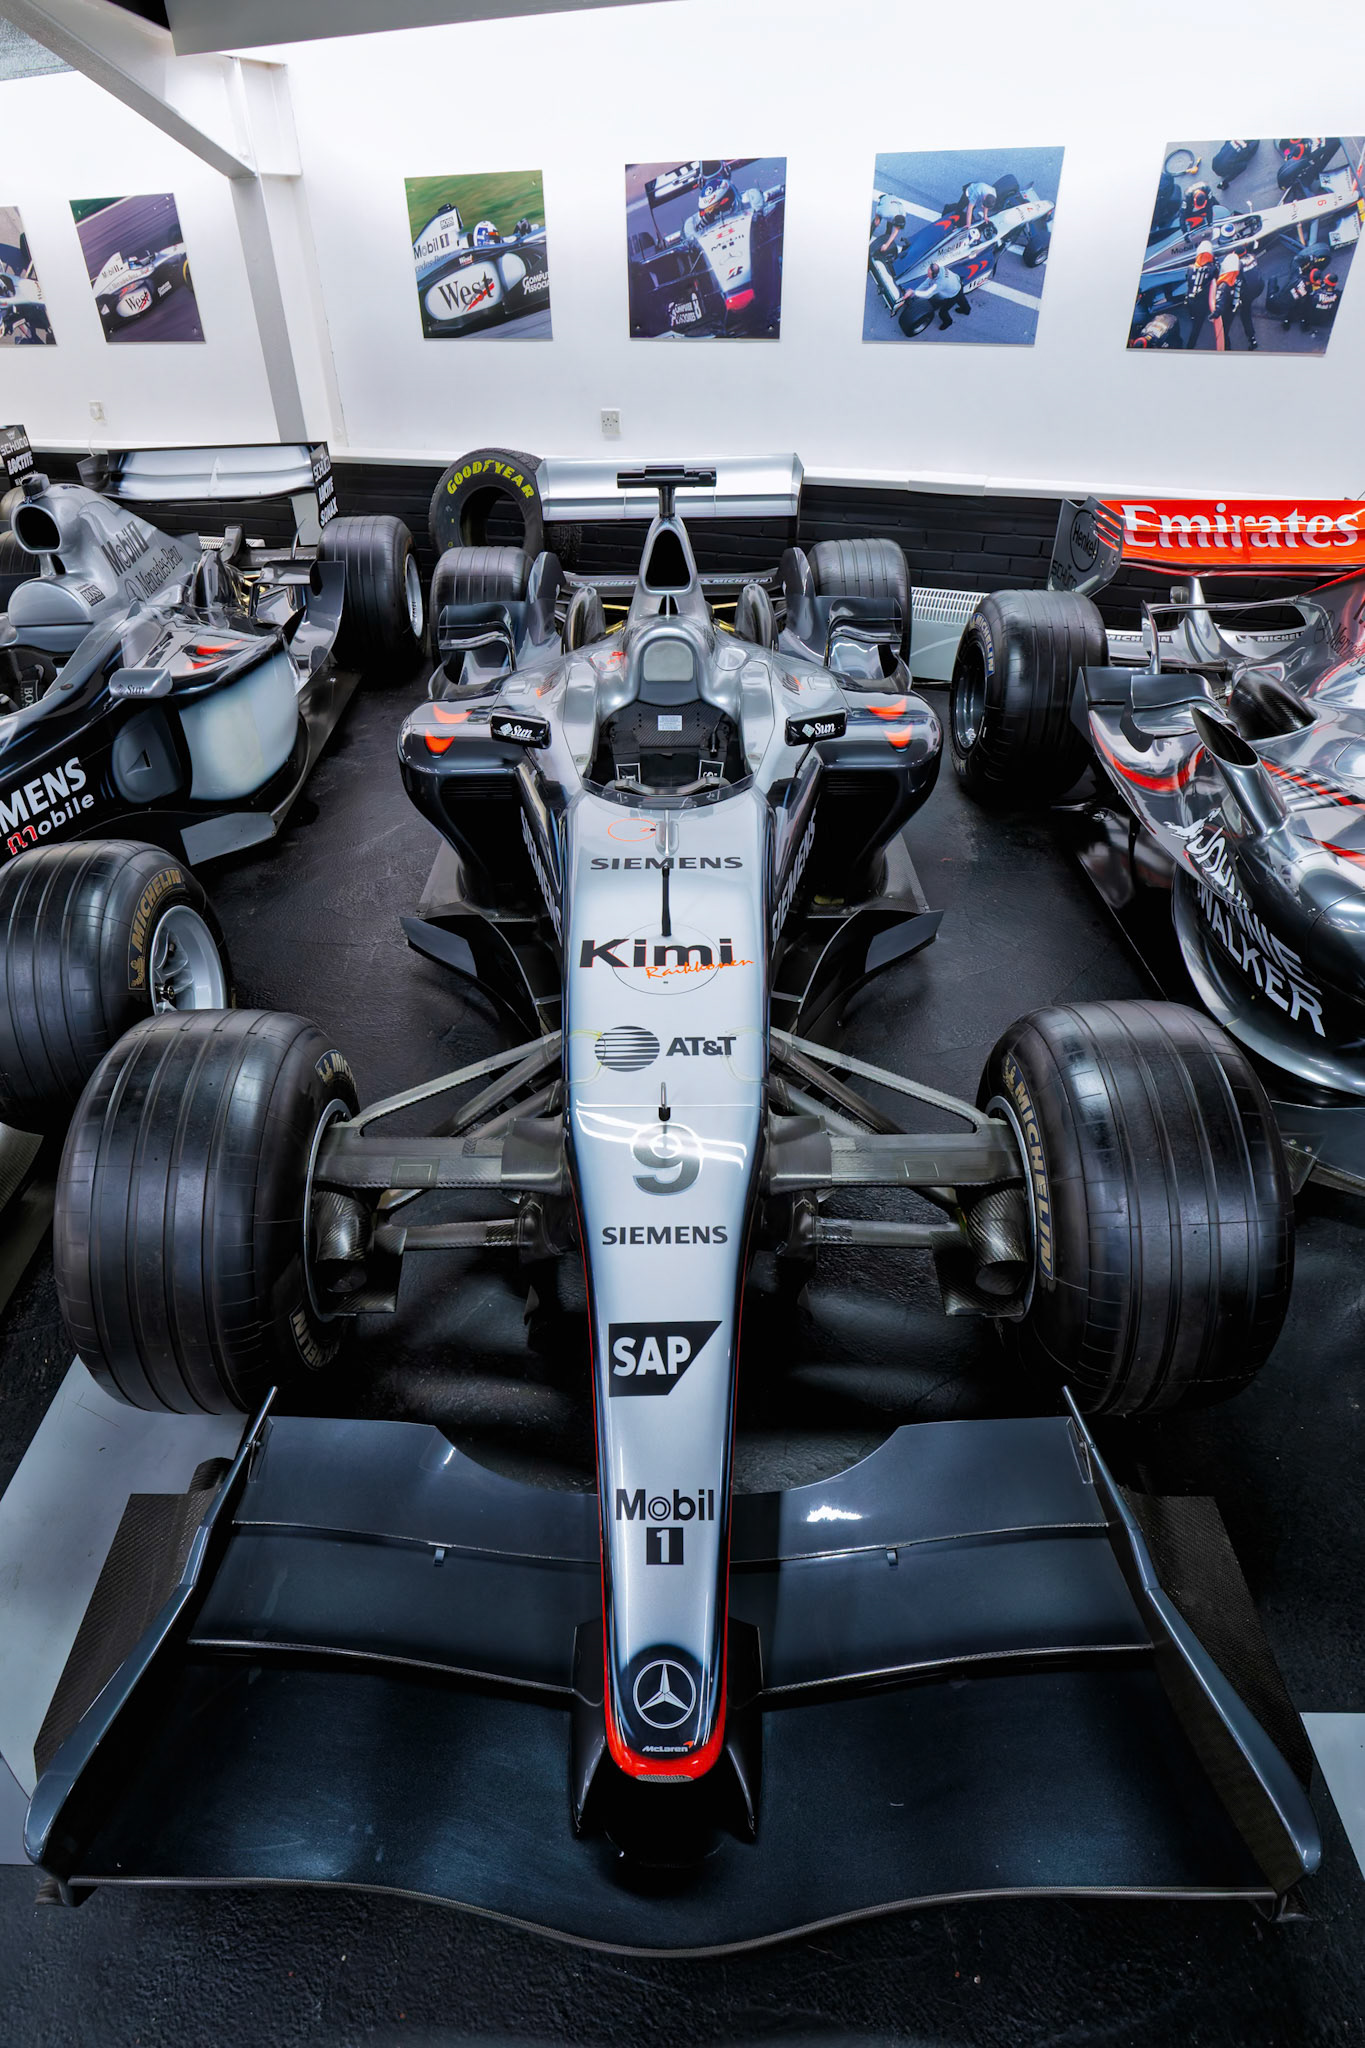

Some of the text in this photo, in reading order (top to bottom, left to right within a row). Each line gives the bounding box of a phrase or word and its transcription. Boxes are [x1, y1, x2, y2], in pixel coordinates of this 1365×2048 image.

[438, 271, 495, 312] West
[7, 451, 34, 475] LOCTITE
[1072, 521, 1098, 559] Henkel
[1121, 503, 1359, 548] Emirates
[101, 527, 142, 577] Mobil
[135, 545, 183, 599] Mercedes-Benz
[713, 577, 769, 585] MICHELIN
[975, 614, 994, 671] MICHELIN
[1107, 635, 1170, 643] MICHIN
[126, 684, 145, 694] Sun
[511, 725, 532, 738] Sun
[814, 723, 835, 735] Sun
[590, 857, 743, 870] SIEMENS
[772, 807, 816, 956] SIEMENS
[132, 869, 182, 953] MICHELIN
[579, 938, 733, 968] Kimi
[666, 1036, 736, 1057] AT&T
[631, 1122, 703, 1196] 9
[1015, 1080, 1053, 1278] MICHELIN
[602, 1225, 728, 1245] SIEMENS
[613, 1336, 691, 1377] SAP
[615, 1488, 715, 1521] Mobil
